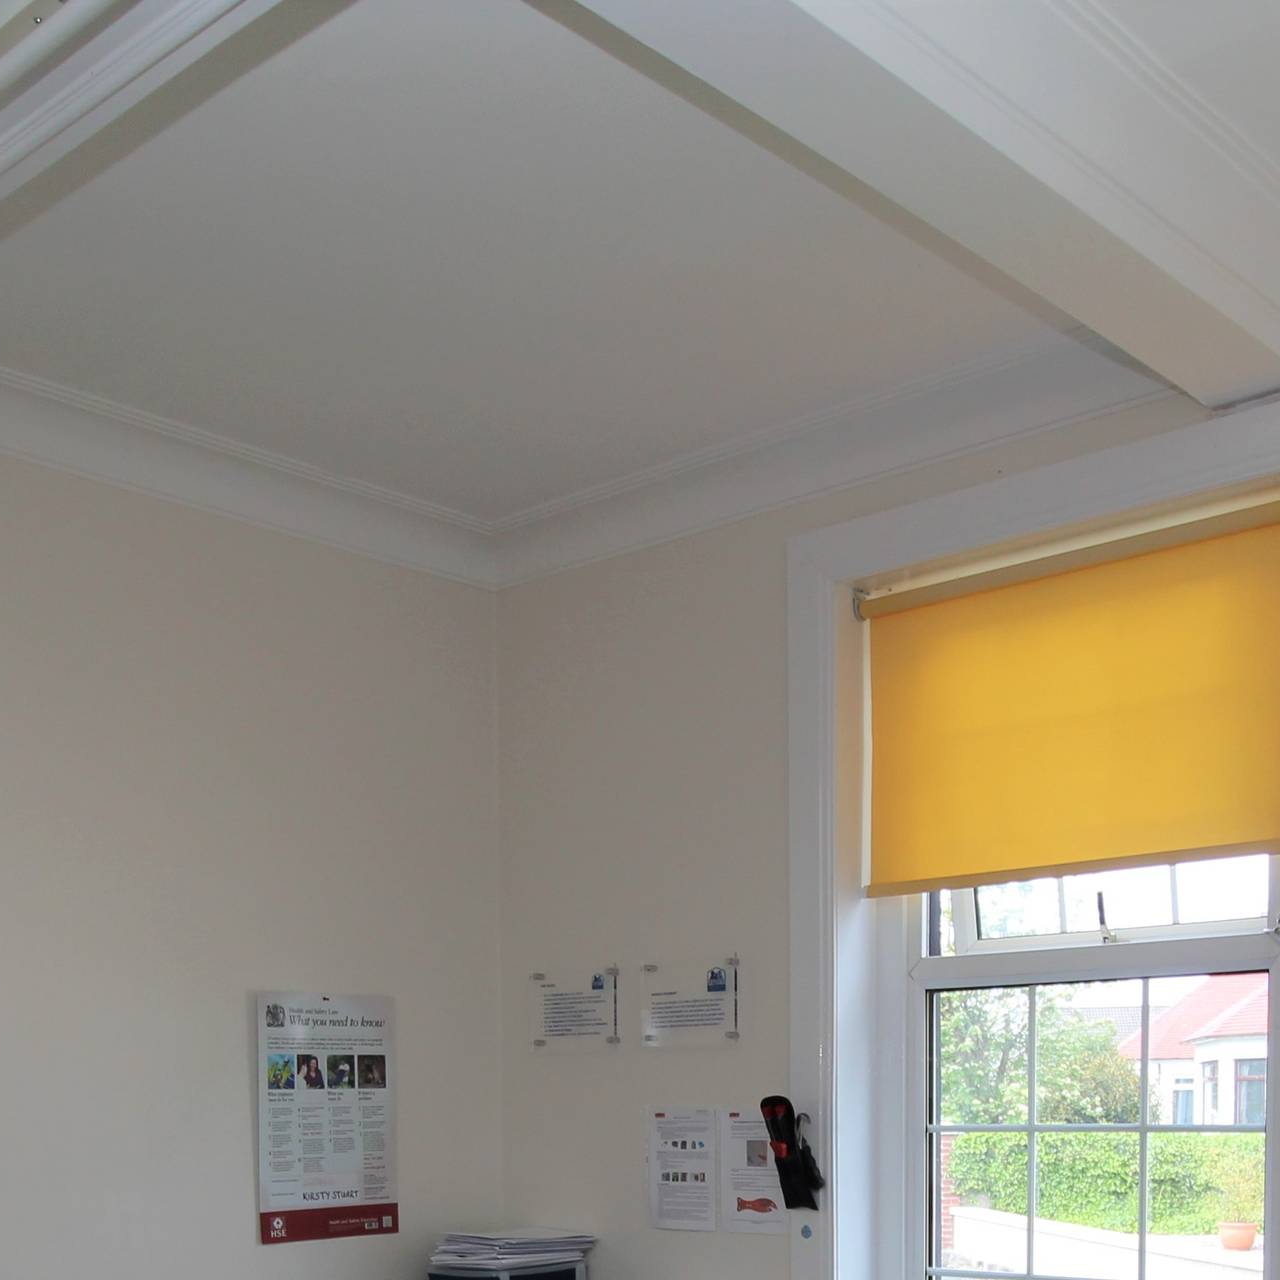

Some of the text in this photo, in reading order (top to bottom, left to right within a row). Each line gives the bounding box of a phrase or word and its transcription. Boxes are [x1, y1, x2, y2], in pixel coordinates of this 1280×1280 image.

[289, 1016, 385, 1029] What you need to know
[302, 1190, 359, 1201] KIRSTY STUART
[271, 1229, 287, 1238] HSE
